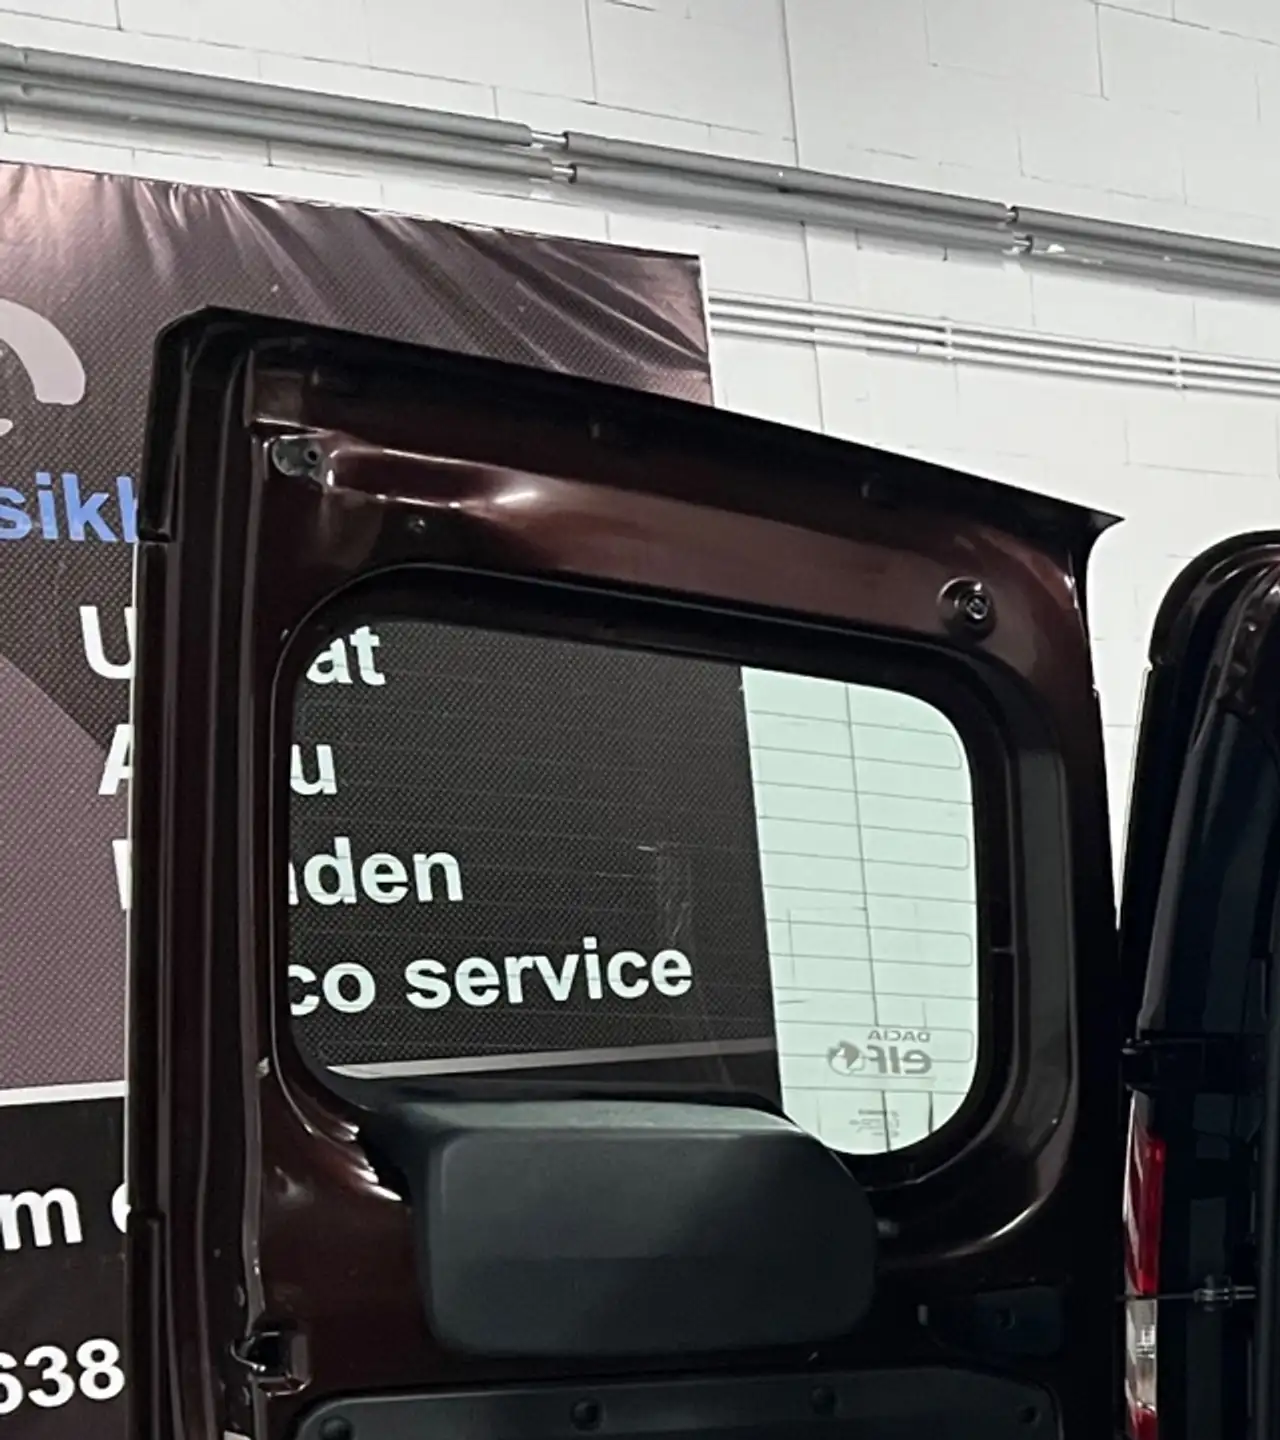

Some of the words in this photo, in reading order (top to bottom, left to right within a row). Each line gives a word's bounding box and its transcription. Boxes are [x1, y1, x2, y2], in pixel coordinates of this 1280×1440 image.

[288, 836, 463, 905] den
[289, 961, 376, 1015] co
[404, 936, 693, 1009] service
